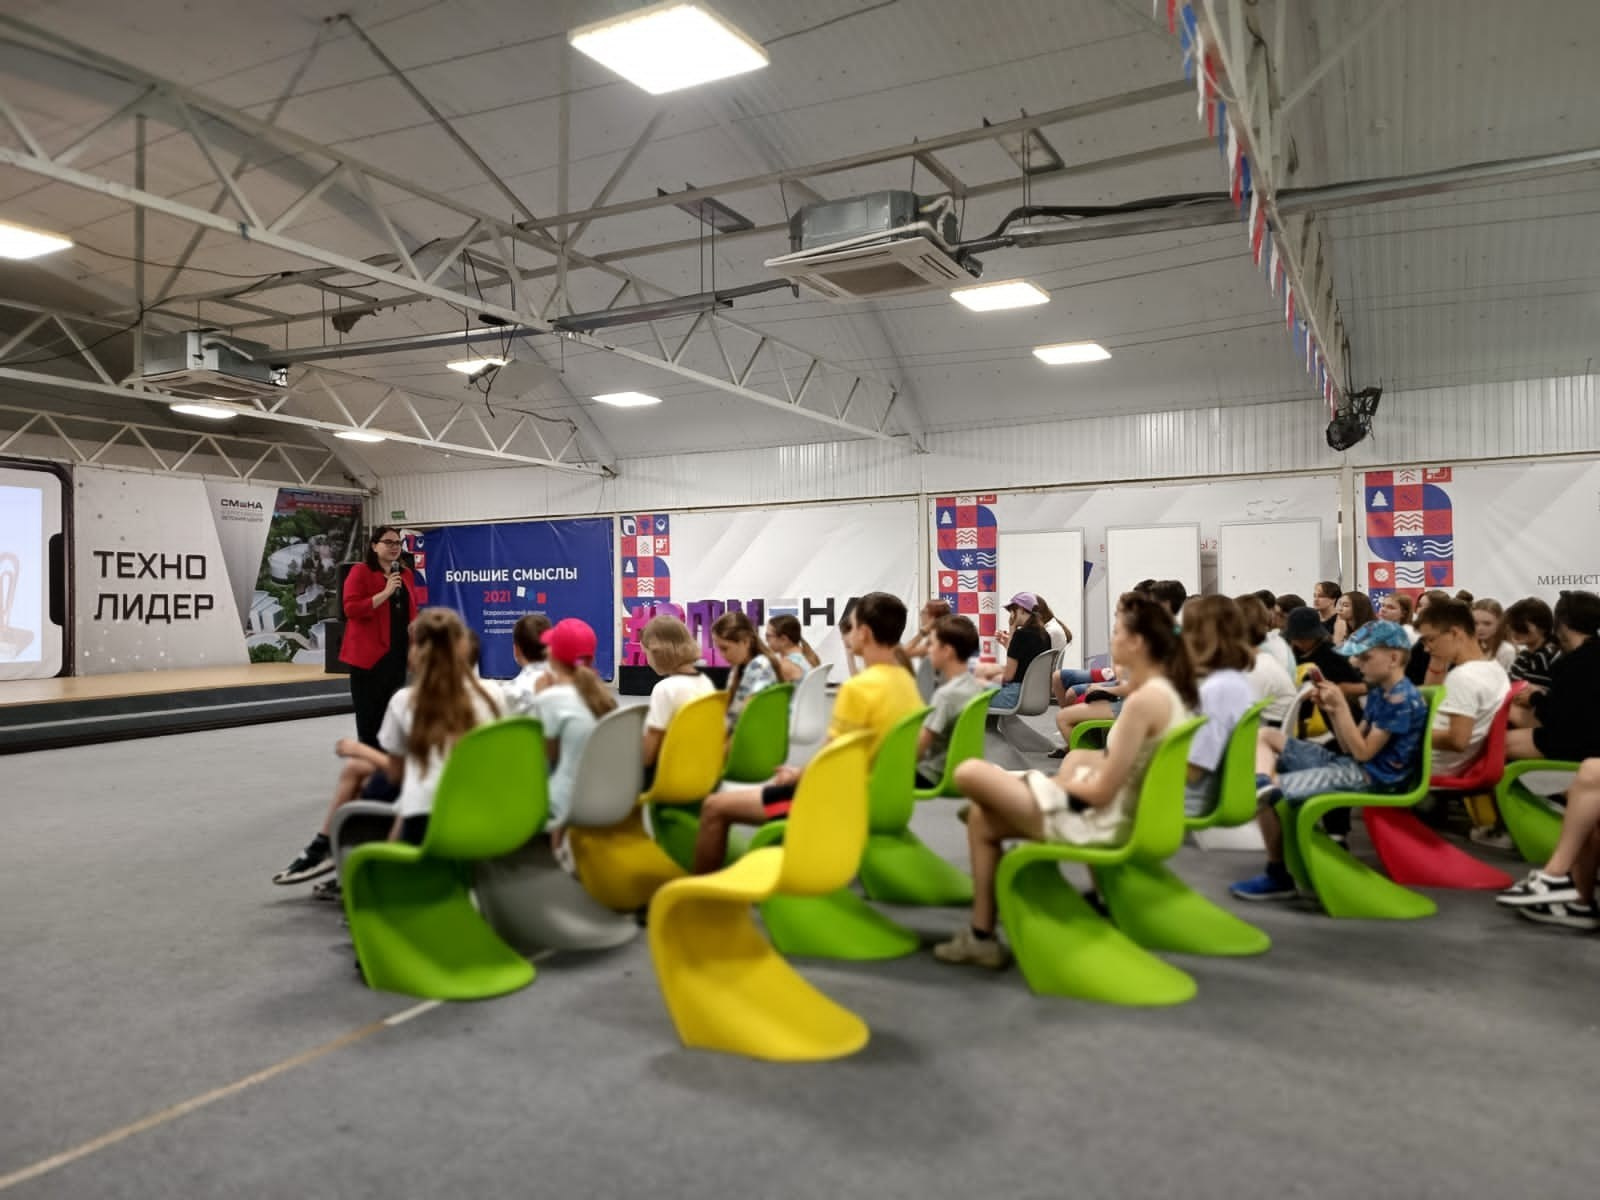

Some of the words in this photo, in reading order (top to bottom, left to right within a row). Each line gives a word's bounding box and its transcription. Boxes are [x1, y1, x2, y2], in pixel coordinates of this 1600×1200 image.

[93, 551, 206, 579] ТЕХНО
[445, 569, 510, 582] БОЛЬШИЕ
[512, 567, 577, 581] СМЫСЛЫ
[1537, 574, 1600, 585] МИНИСТ
[483, 590, 512, 603] 2021
[93, 593, 214, 624] ЛИДЕР
